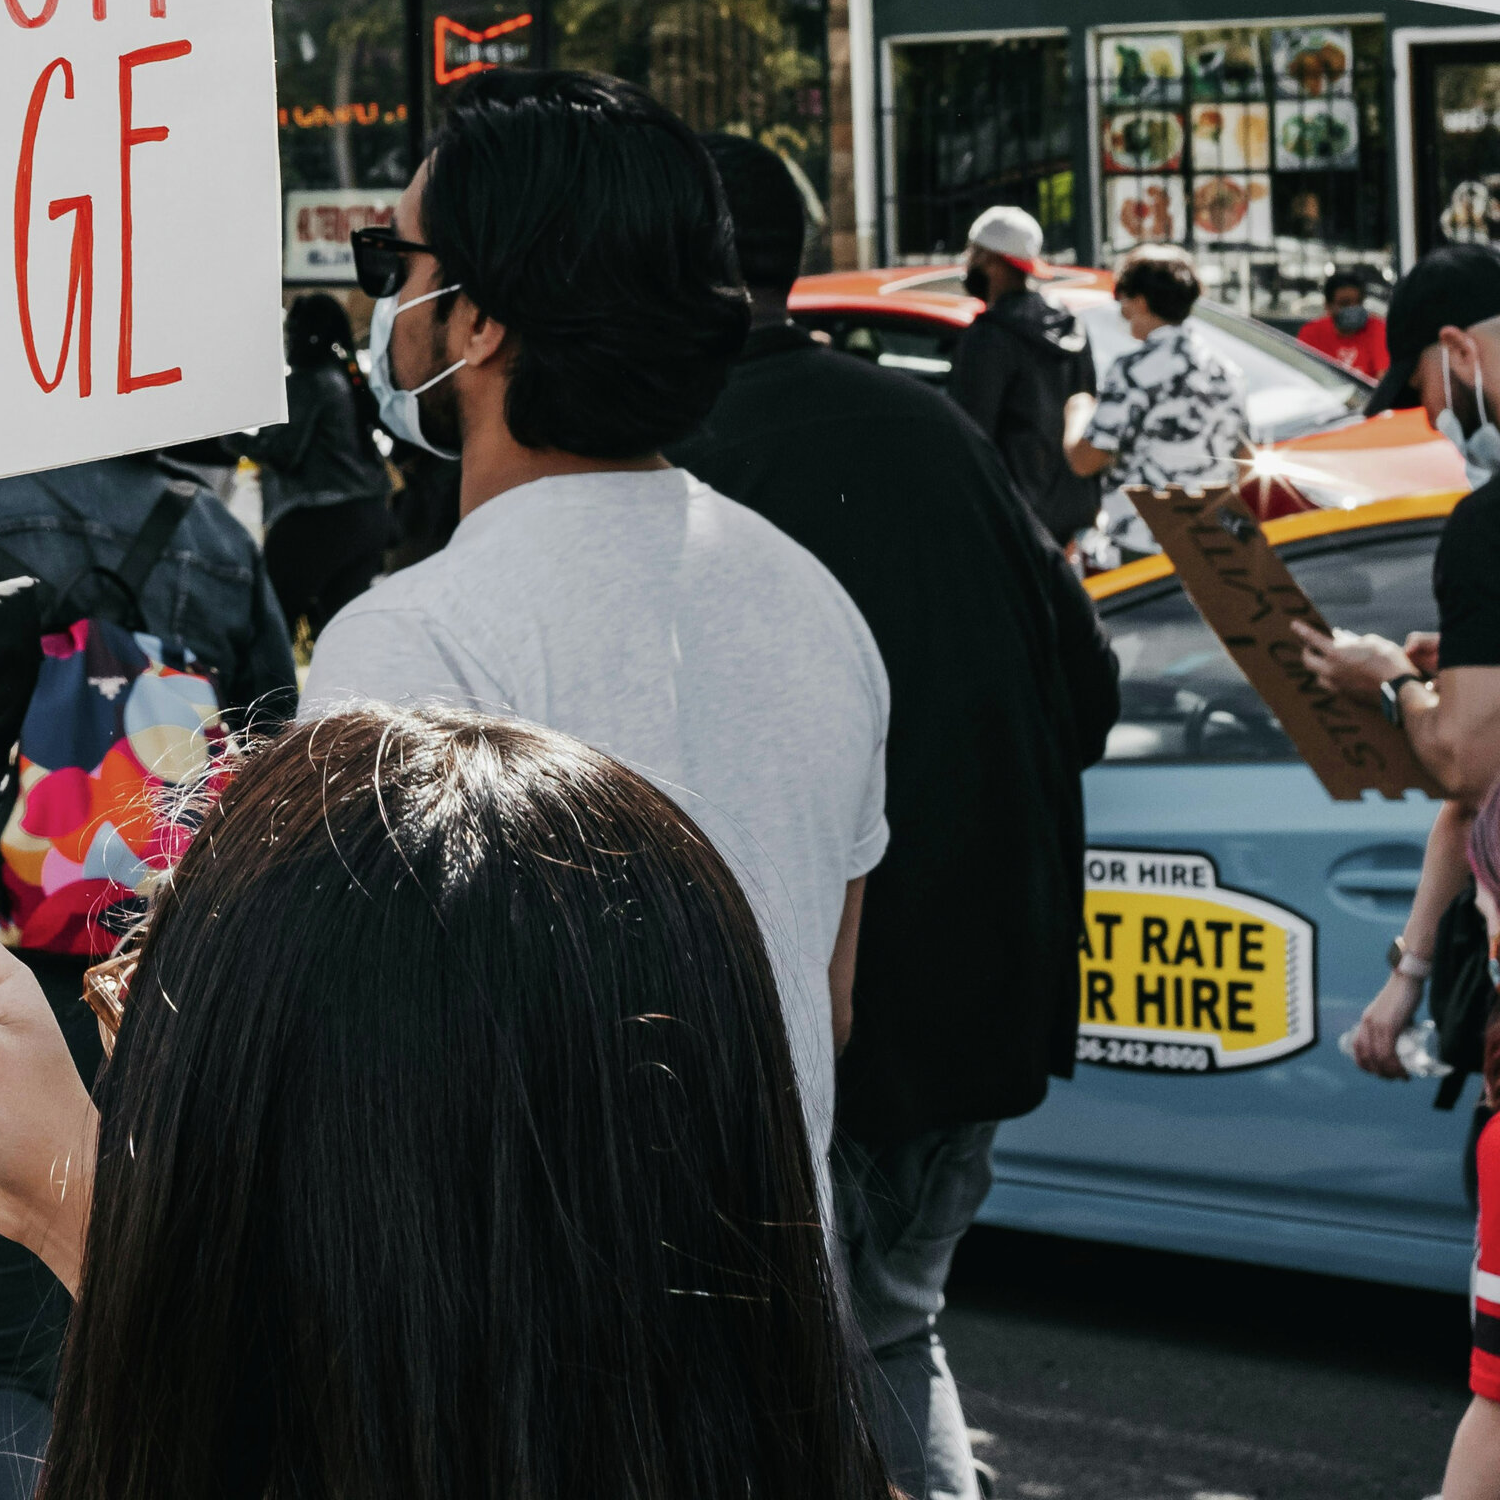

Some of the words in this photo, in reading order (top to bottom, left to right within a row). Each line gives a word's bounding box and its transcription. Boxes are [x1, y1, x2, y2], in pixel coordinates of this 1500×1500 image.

[1138, 862, 1207, 888] HIRE
[1142, 916, 1265, 972] RATE
[1135, 973, 1256, 1034] HIRE
